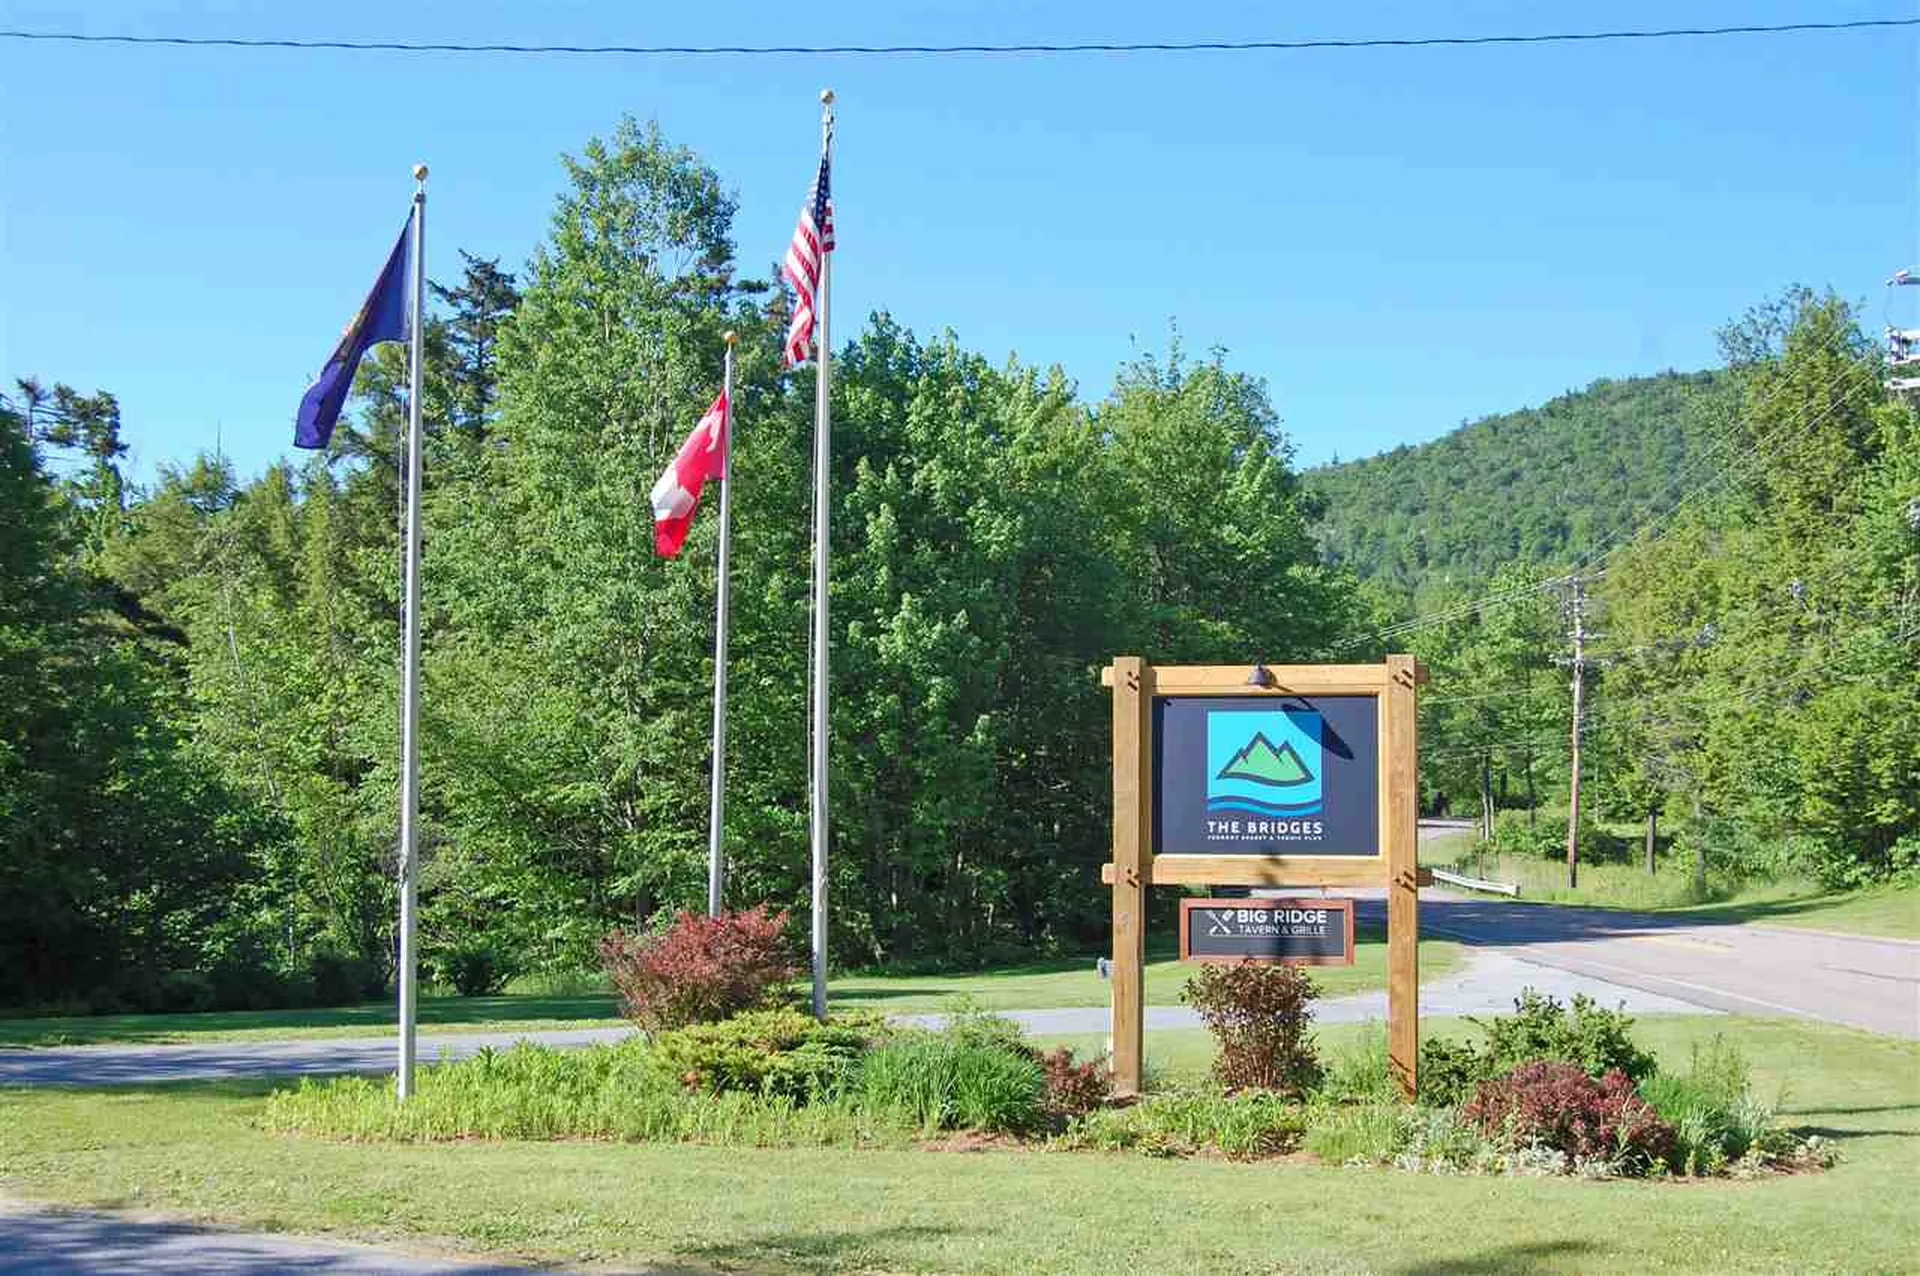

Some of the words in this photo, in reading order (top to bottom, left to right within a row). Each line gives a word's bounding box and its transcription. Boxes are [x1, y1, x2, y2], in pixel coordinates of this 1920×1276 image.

[1208, 821, 1240, 834] THE
[1247, 821, 1323, 834] BRIDGES
[1237, 910, 1268, 923] BIG
[1274, 910, 1328, 923] RIDGE
[1239, 925, 1279, 934] TAVERN
[1291, 925, 1326, 935] GRILLE
